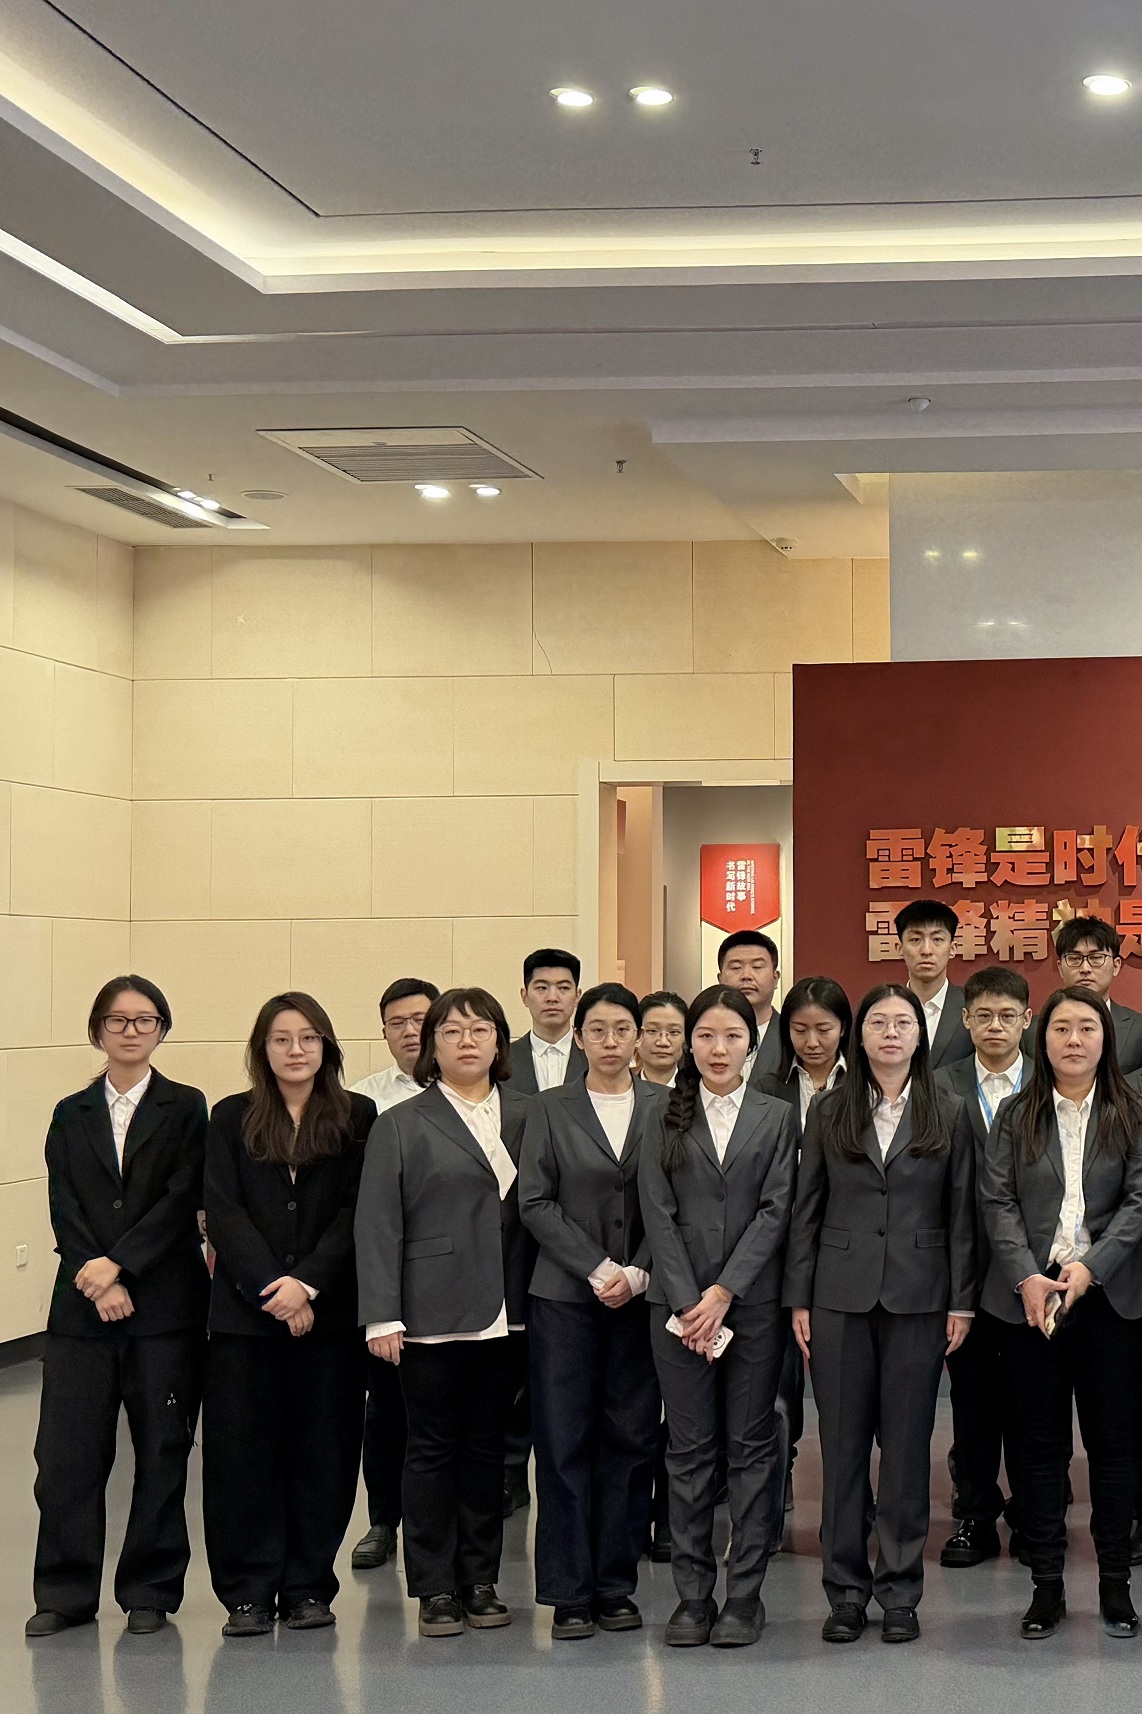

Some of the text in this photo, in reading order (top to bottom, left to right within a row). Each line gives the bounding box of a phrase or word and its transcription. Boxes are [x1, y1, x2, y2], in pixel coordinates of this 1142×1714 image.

[726, 860, 736, 912] 书写新时代
